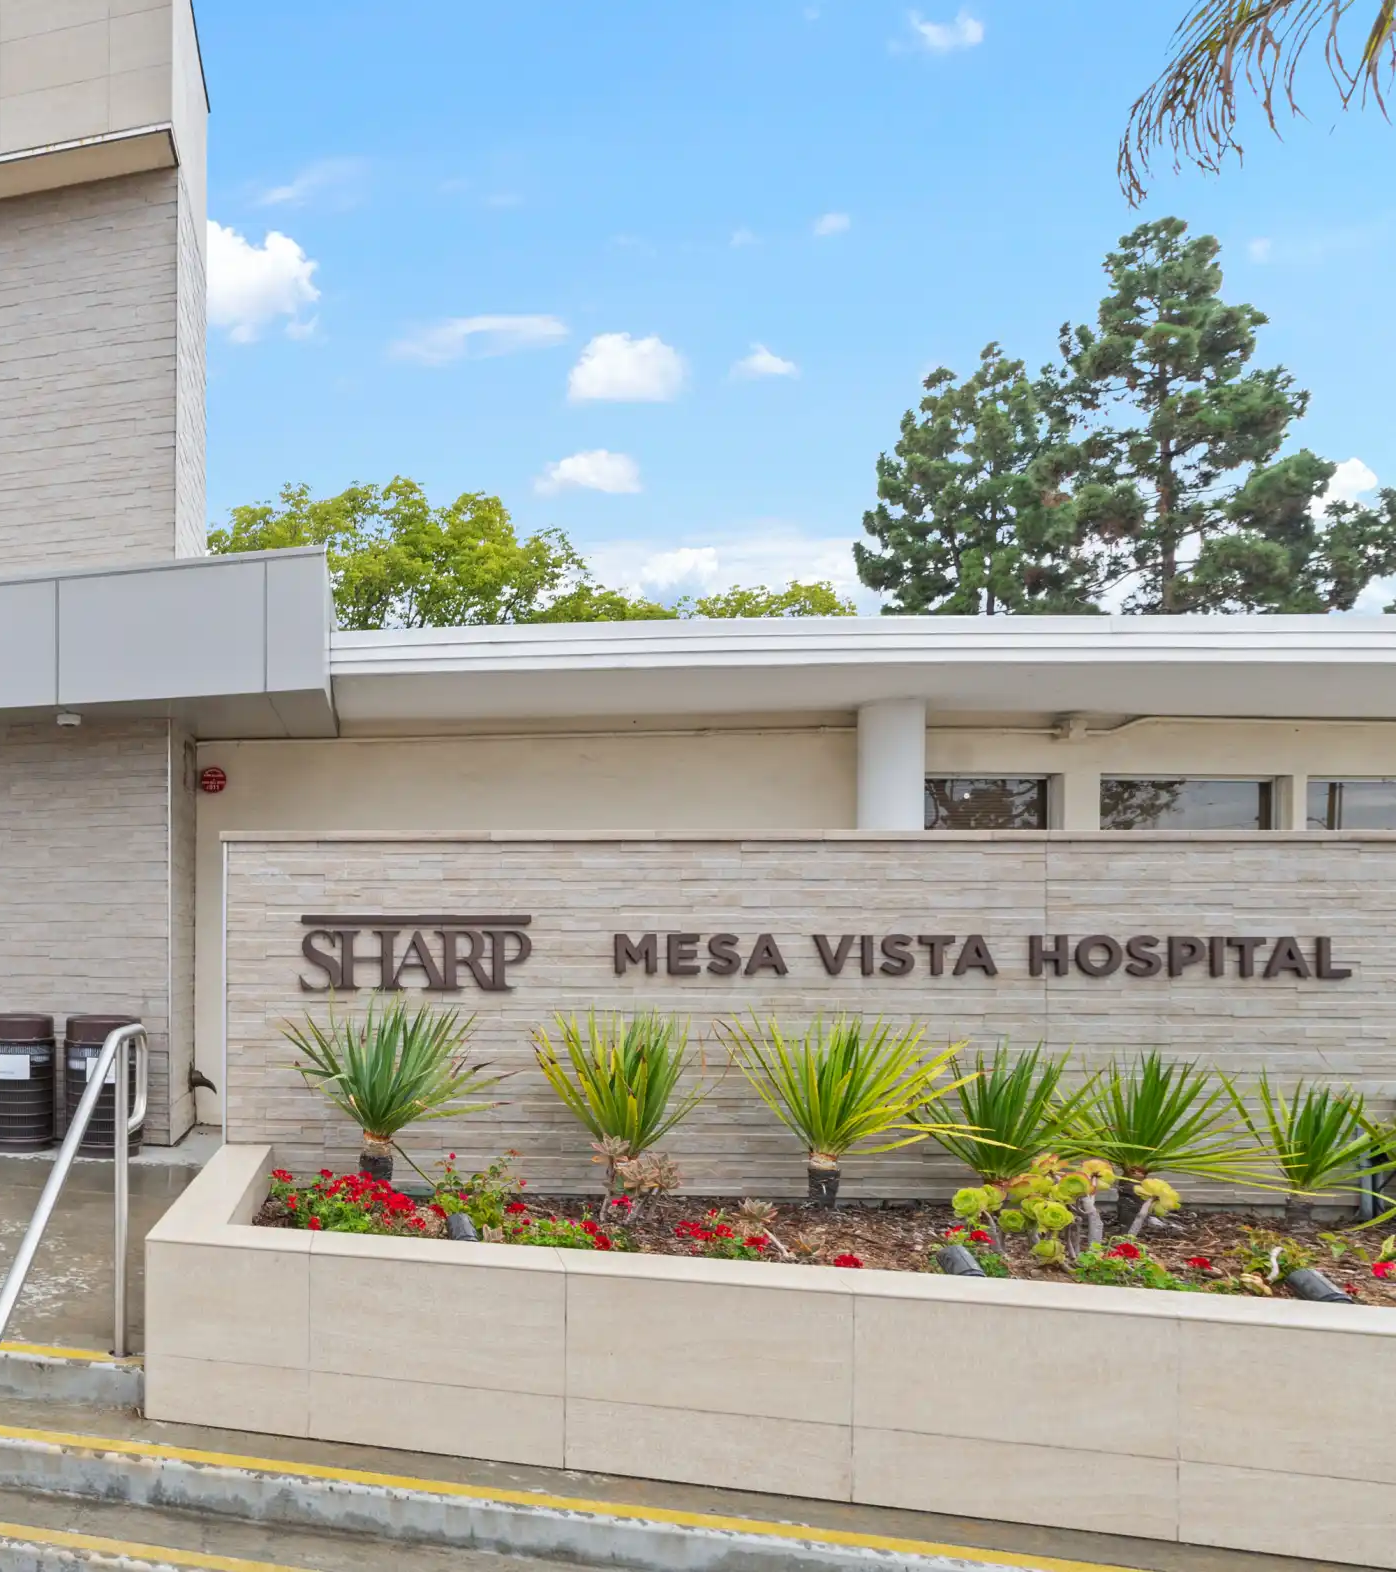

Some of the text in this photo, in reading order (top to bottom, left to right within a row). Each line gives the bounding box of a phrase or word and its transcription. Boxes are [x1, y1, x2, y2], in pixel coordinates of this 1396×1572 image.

[299, 929, 533, 994] SHARP
[613, 933, 1353, 980] MESA VISTA HOSPITAL
